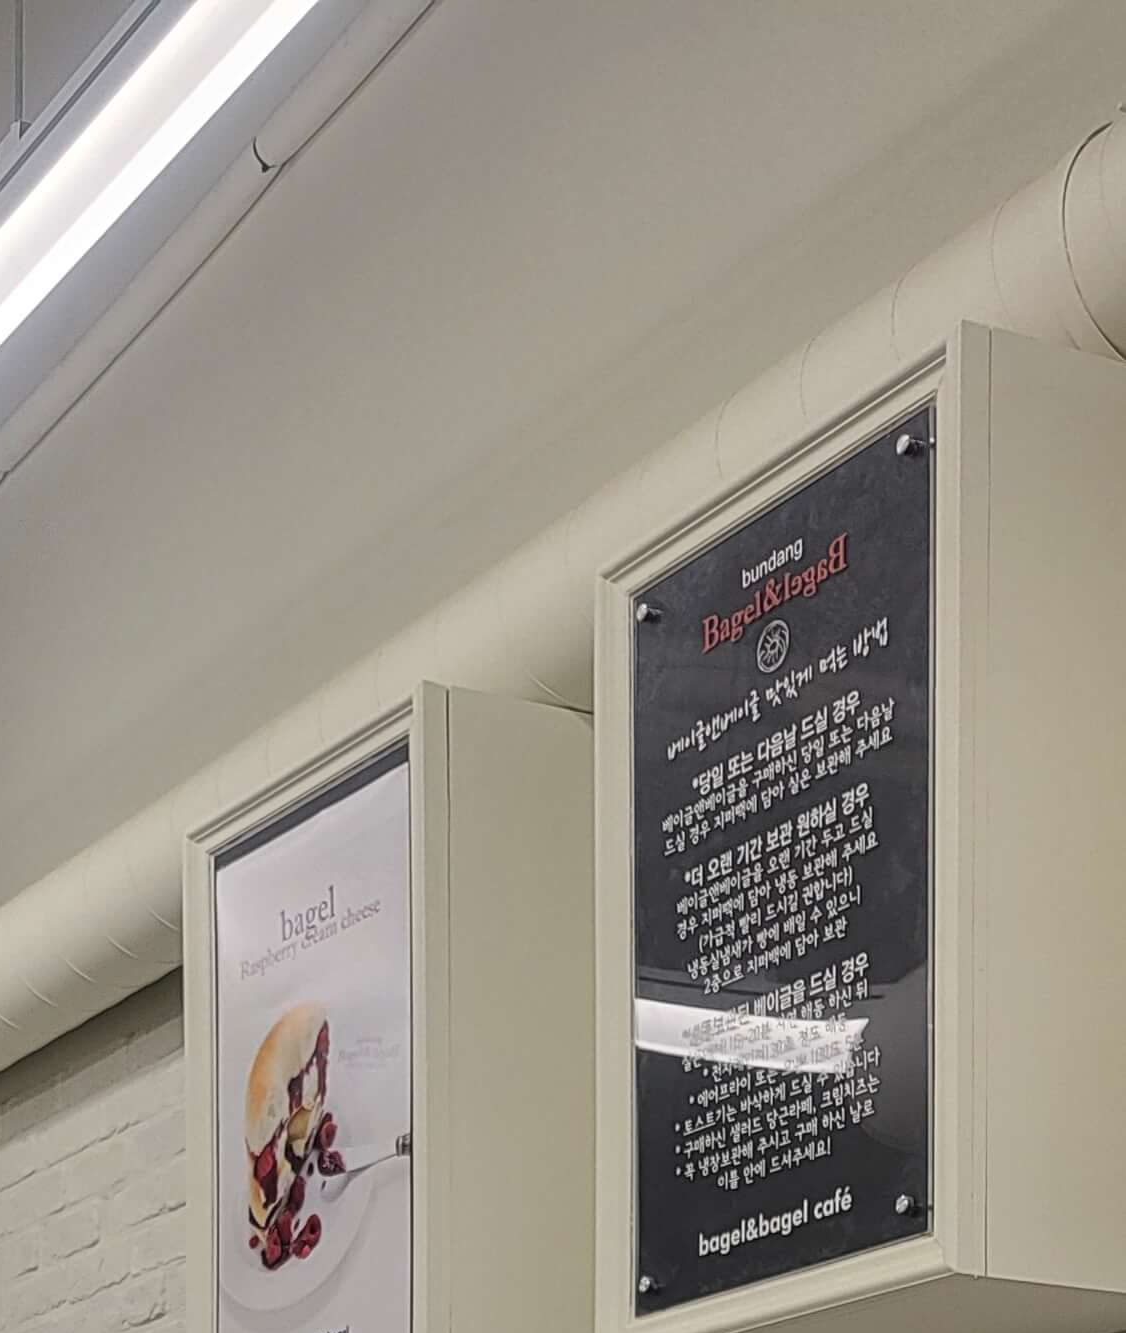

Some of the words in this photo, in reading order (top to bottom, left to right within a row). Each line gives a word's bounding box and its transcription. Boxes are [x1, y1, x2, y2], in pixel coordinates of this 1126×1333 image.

[741, 538, 803, 588] bundang
[667, 689, 761, 761] 베이글앤베이글
[765, 664, 813, 707] 맛있게
[819, 644, 848, 673] 먹는
[853, 617, 888, 657] 방법
[662, 777, 749, 833] 베이글앤베이글을
[752, 749, 797, 788] 구매하신
[801, 735, 825, 764] 당일
[828, 724, 854, 748] 또는
[857, 697, 895, 731] 다음날
[698, 762, 724, 795] 당일
[727, 751, 754, 780] 또는
[757, 723, 798, 761] 다음날
[801, 705, 828, 740] 드실
[832, 690, 861, 724] 경우
[665, 831, 686, 856] 드실
[689, 820, 711, 845] 경우
[760, 780, 784, 810] 담아
[788, 768, 812, 795] 실온
[815, 744, 851, 780] 보관해
[855, 726, 893, 758] 주세요
[690, 863, 703, 887] 더
[707, 849, 733, 881] 오랜
[736, 834, 762, 864] 기간
[765, 819, 793, 853] 보관
[796, 796, 837, 838] 원하실
[841, 782, 870, 815] 경우
[676, 862, 763, 915] 베이글앤베이글을
[766, 847, 791, 874] 오랜
[794, 834, 818, 859] 기간
[821, 822, 846, 848] 두고
[849, 805, 873, 834] 드실
[676, 915, 699, 941] 경우
[747, 879, 772, 908] 담아
[774, 867, 799, 895] 냉동
[801, 847, 838, 881] 보관해
[841, 830, 879, 862] 주세요
[280, 884, 335, 943] bagel
[340, 899, 381, 930] cheese
[687, 934, 754, 981] 냉동실냄새가
[756, 921, 781, 950] 빵에
[783, 910, 806, 935] 배일
[809, 904, 823, 924] 수
[826, 883, 861, 920] 있으니
[698, 919, 735, 954] (가급적
[738, 907, 762, 936] 빨리
[765, 890, 798, 922] 드시길
[802, 865, 853, 906] 권합니다)
[703, 963, 745, 995] 2중으로
[794, 927, 819, 957] 담아
[822, 915, 848, 942] 보관
[754, 978, 806, 1018] 베이글을
[809, 964, 837, 996] 드실
[841, 951, 870, 984] 경우
[801, 998, 825, 1020] 해동
[828, 986, 852, 1008] 하신
[855, 977, 868, 1000] 뒤
[683, 1103, 737, 1136] 토스트기는
[740, 1080, 786, 1115] 바삭하게
[789, 1071, 812, 1096] 드실
[834, 1045, 881, 1083] 있습니다
[684, 1126, 726, 1160] 구매하신
[730, 1116, 763, 1143] 샐러드
[820, 1073, 880, 1108] 크림치즈는
[697, 1072, 751, 1107] 에어프라이
[684, 1162, 696, 1181] 꼭
[698, 1139, 754, 1177] 냉장보관해
[757, 1128, 791, 1155] 주시고
[794, 1115, 818, 1142] 구매
[822, 1106, 845, 1131] 하신
[849, 1098, 875, 1125] 날로
[743, 1157, 766, 1185] 안에
[698, 1199, 808, 1256] bagel&bagel
[813, 1186, 853, 1222] café
